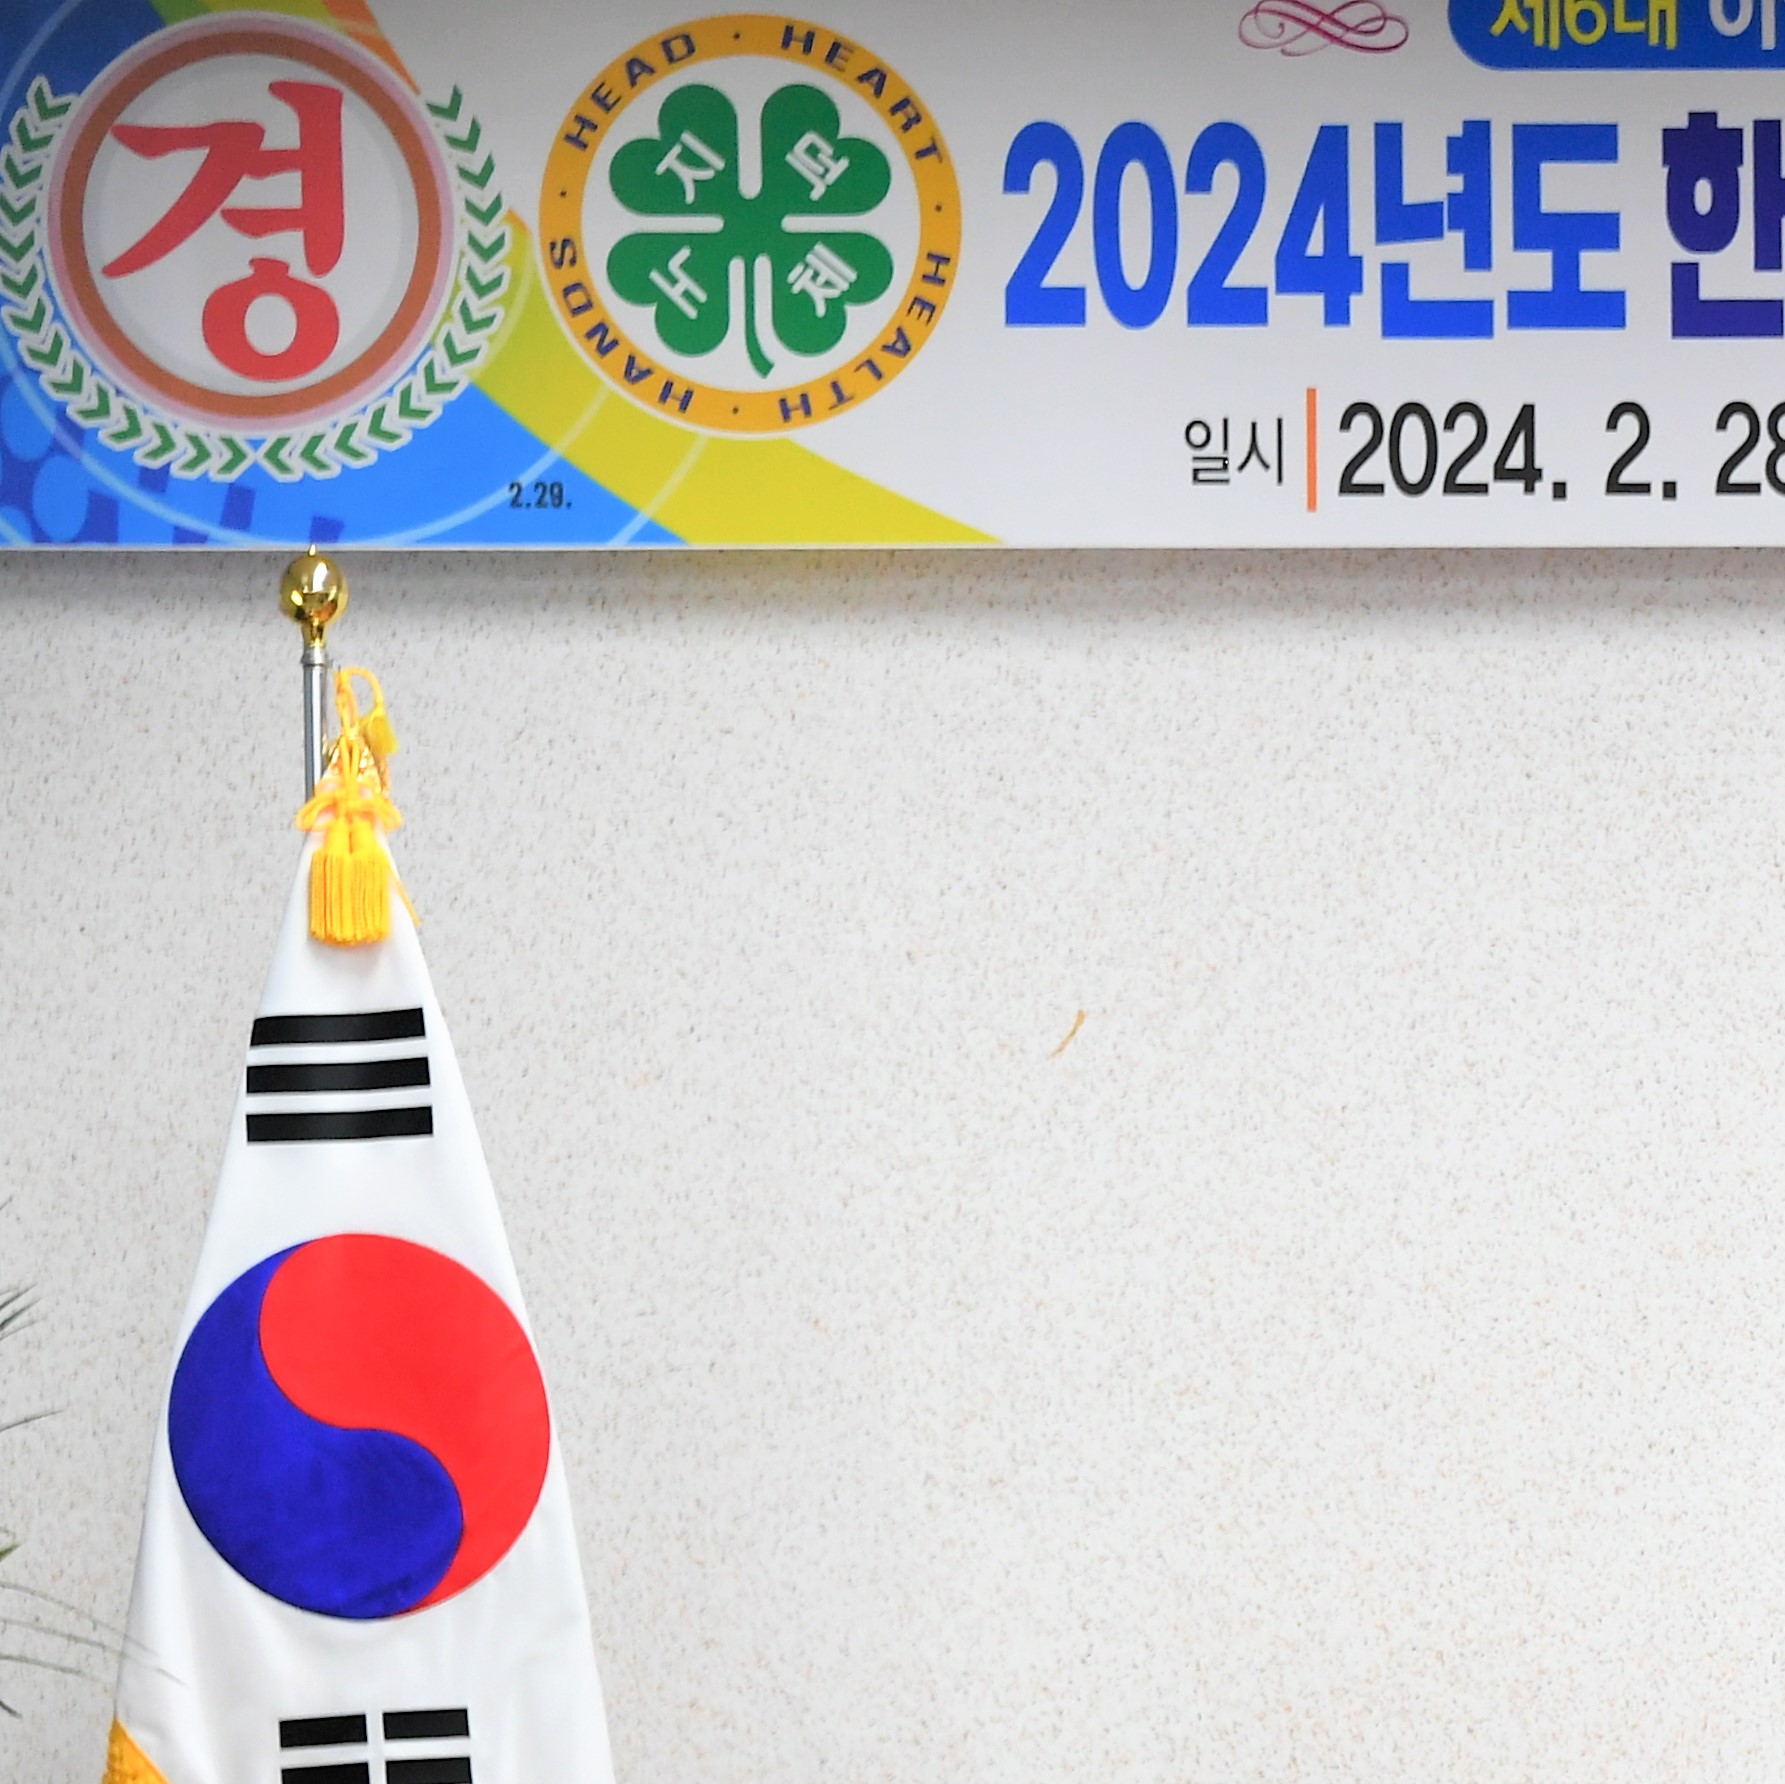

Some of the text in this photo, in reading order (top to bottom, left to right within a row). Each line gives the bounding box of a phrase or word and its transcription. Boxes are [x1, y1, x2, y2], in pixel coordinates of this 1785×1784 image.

[564, 32, 696, 152] HEAD
[780, 24, 942, 166] HEART
[101, 80, 345, 381] 경
[1003, 119, 1628, 341] 2024년도
[549, 236, 694, 415] HANDS
[777, 251, 951, 424] HEALTH
[508, 482, 573, 508] 2.29.
[1183, 416, 1284, 485] 일시
[1338, 401, 1568, 500] 2024.
[1605, 401, 1678, 500] 2.
